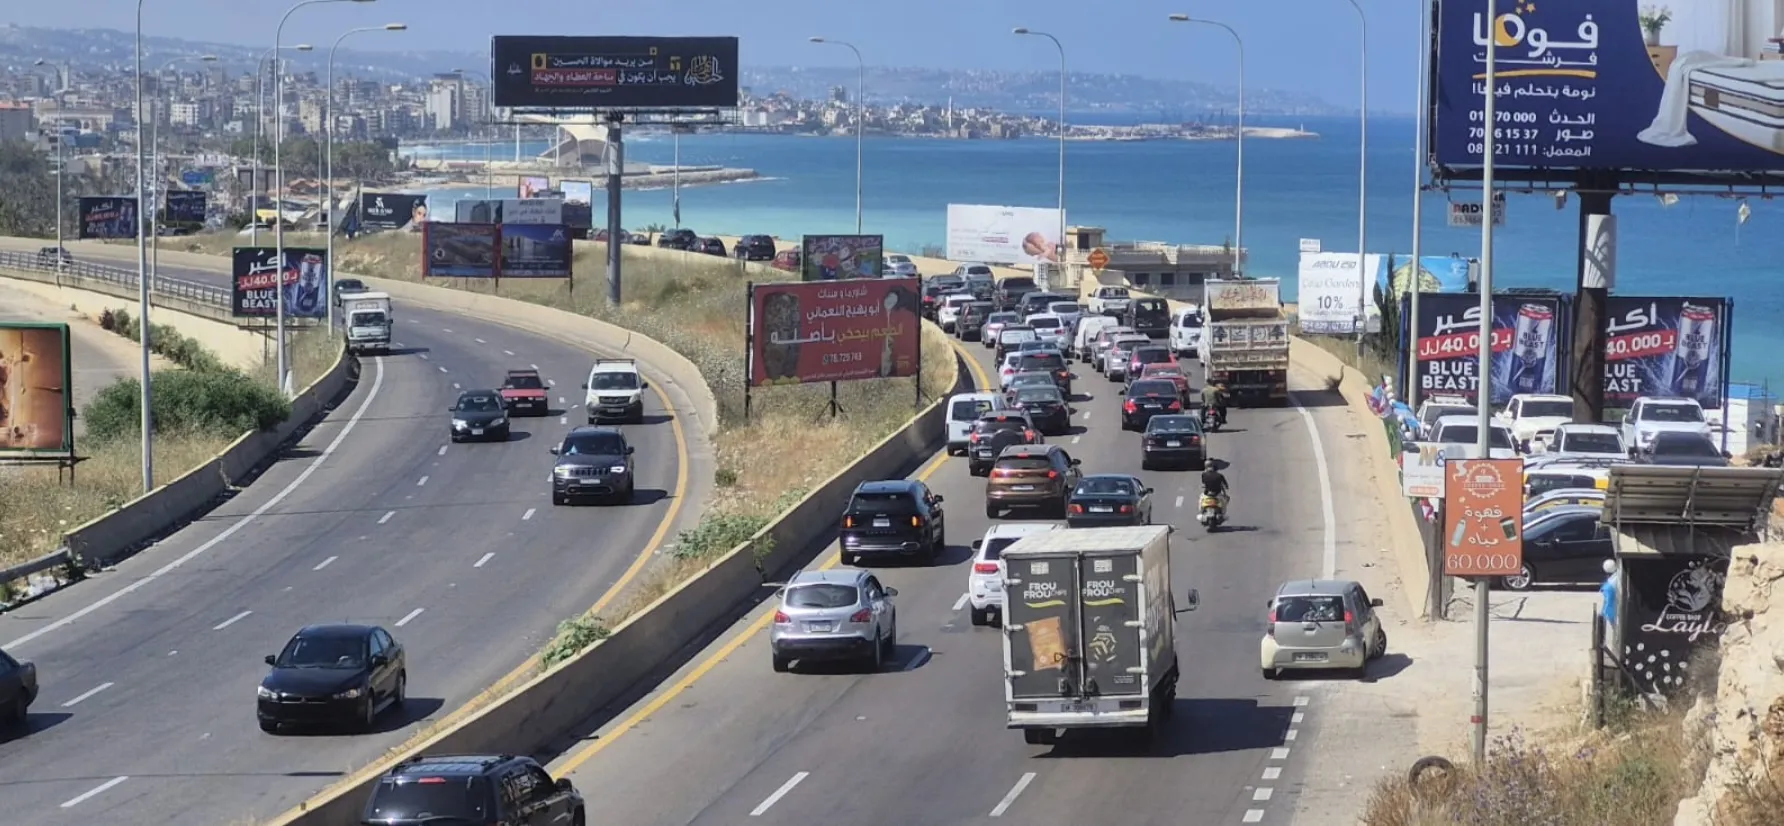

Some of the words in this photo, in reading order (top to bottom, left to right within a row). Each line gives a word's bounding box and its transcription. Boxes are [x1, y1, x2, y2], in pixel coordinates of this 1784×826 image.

[1513, 112, 1537, 123] 000
[1523, 129, 1539, 139] 37
[1555, 129, 1594, 142] صور
[1516, 144, 1537, 155] 111
[246, 290, 275, 300] BLUE
[242, 299, 278, 309] BEAST
[1429, 360, 1473, 375] BLUE
[1604, 364, 1636, 378] LUE
[1422, 374, 1480, 390] BEAST
[1464, 504, 1502, 522] قهوة
[1029, 581, 1057, 591] FROU
[1087, 579, 1115, 589] FROU
[1023, 589, 1051, 599] FROU
[1082, 587, 1109, 597] FROU
